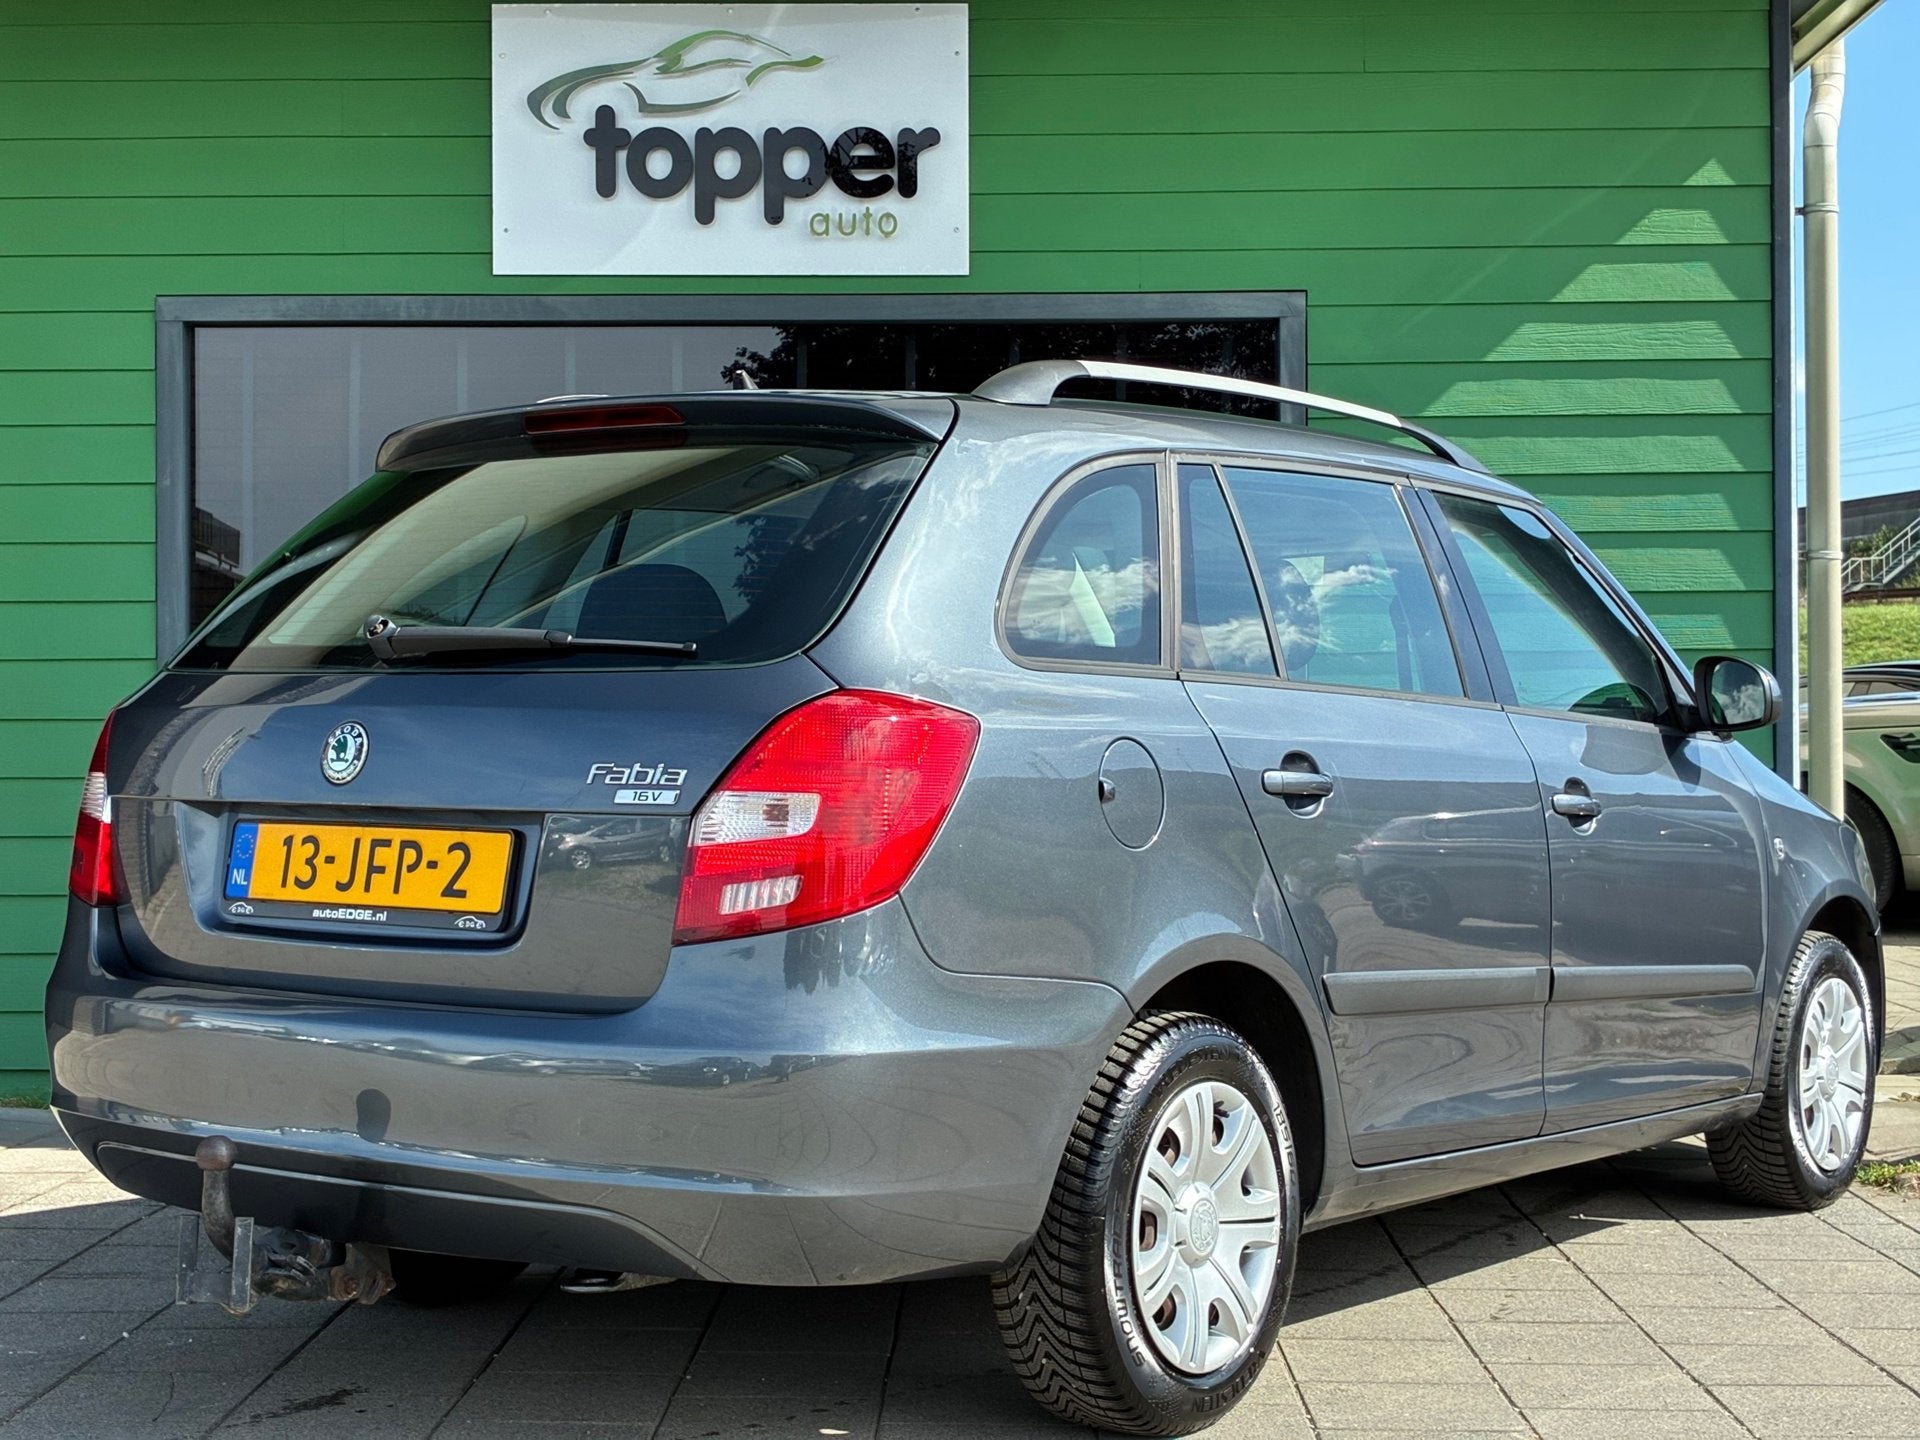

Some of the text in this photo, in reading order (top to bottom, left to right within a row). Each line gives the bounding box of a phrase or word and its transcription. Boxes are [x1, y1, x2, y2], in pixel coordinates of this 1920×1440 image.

[583, 104, 941, 225] topper
[809, 206, 898, 238] auto
[586, 763, 688, 786] Fabia
[632, 791, 663, 802] 16V
[232, 868, 248, 886] NL
[281, 835, 472, 899] 13-JFP-2
[312, 908, 388, 921] autoEDGE.nl
